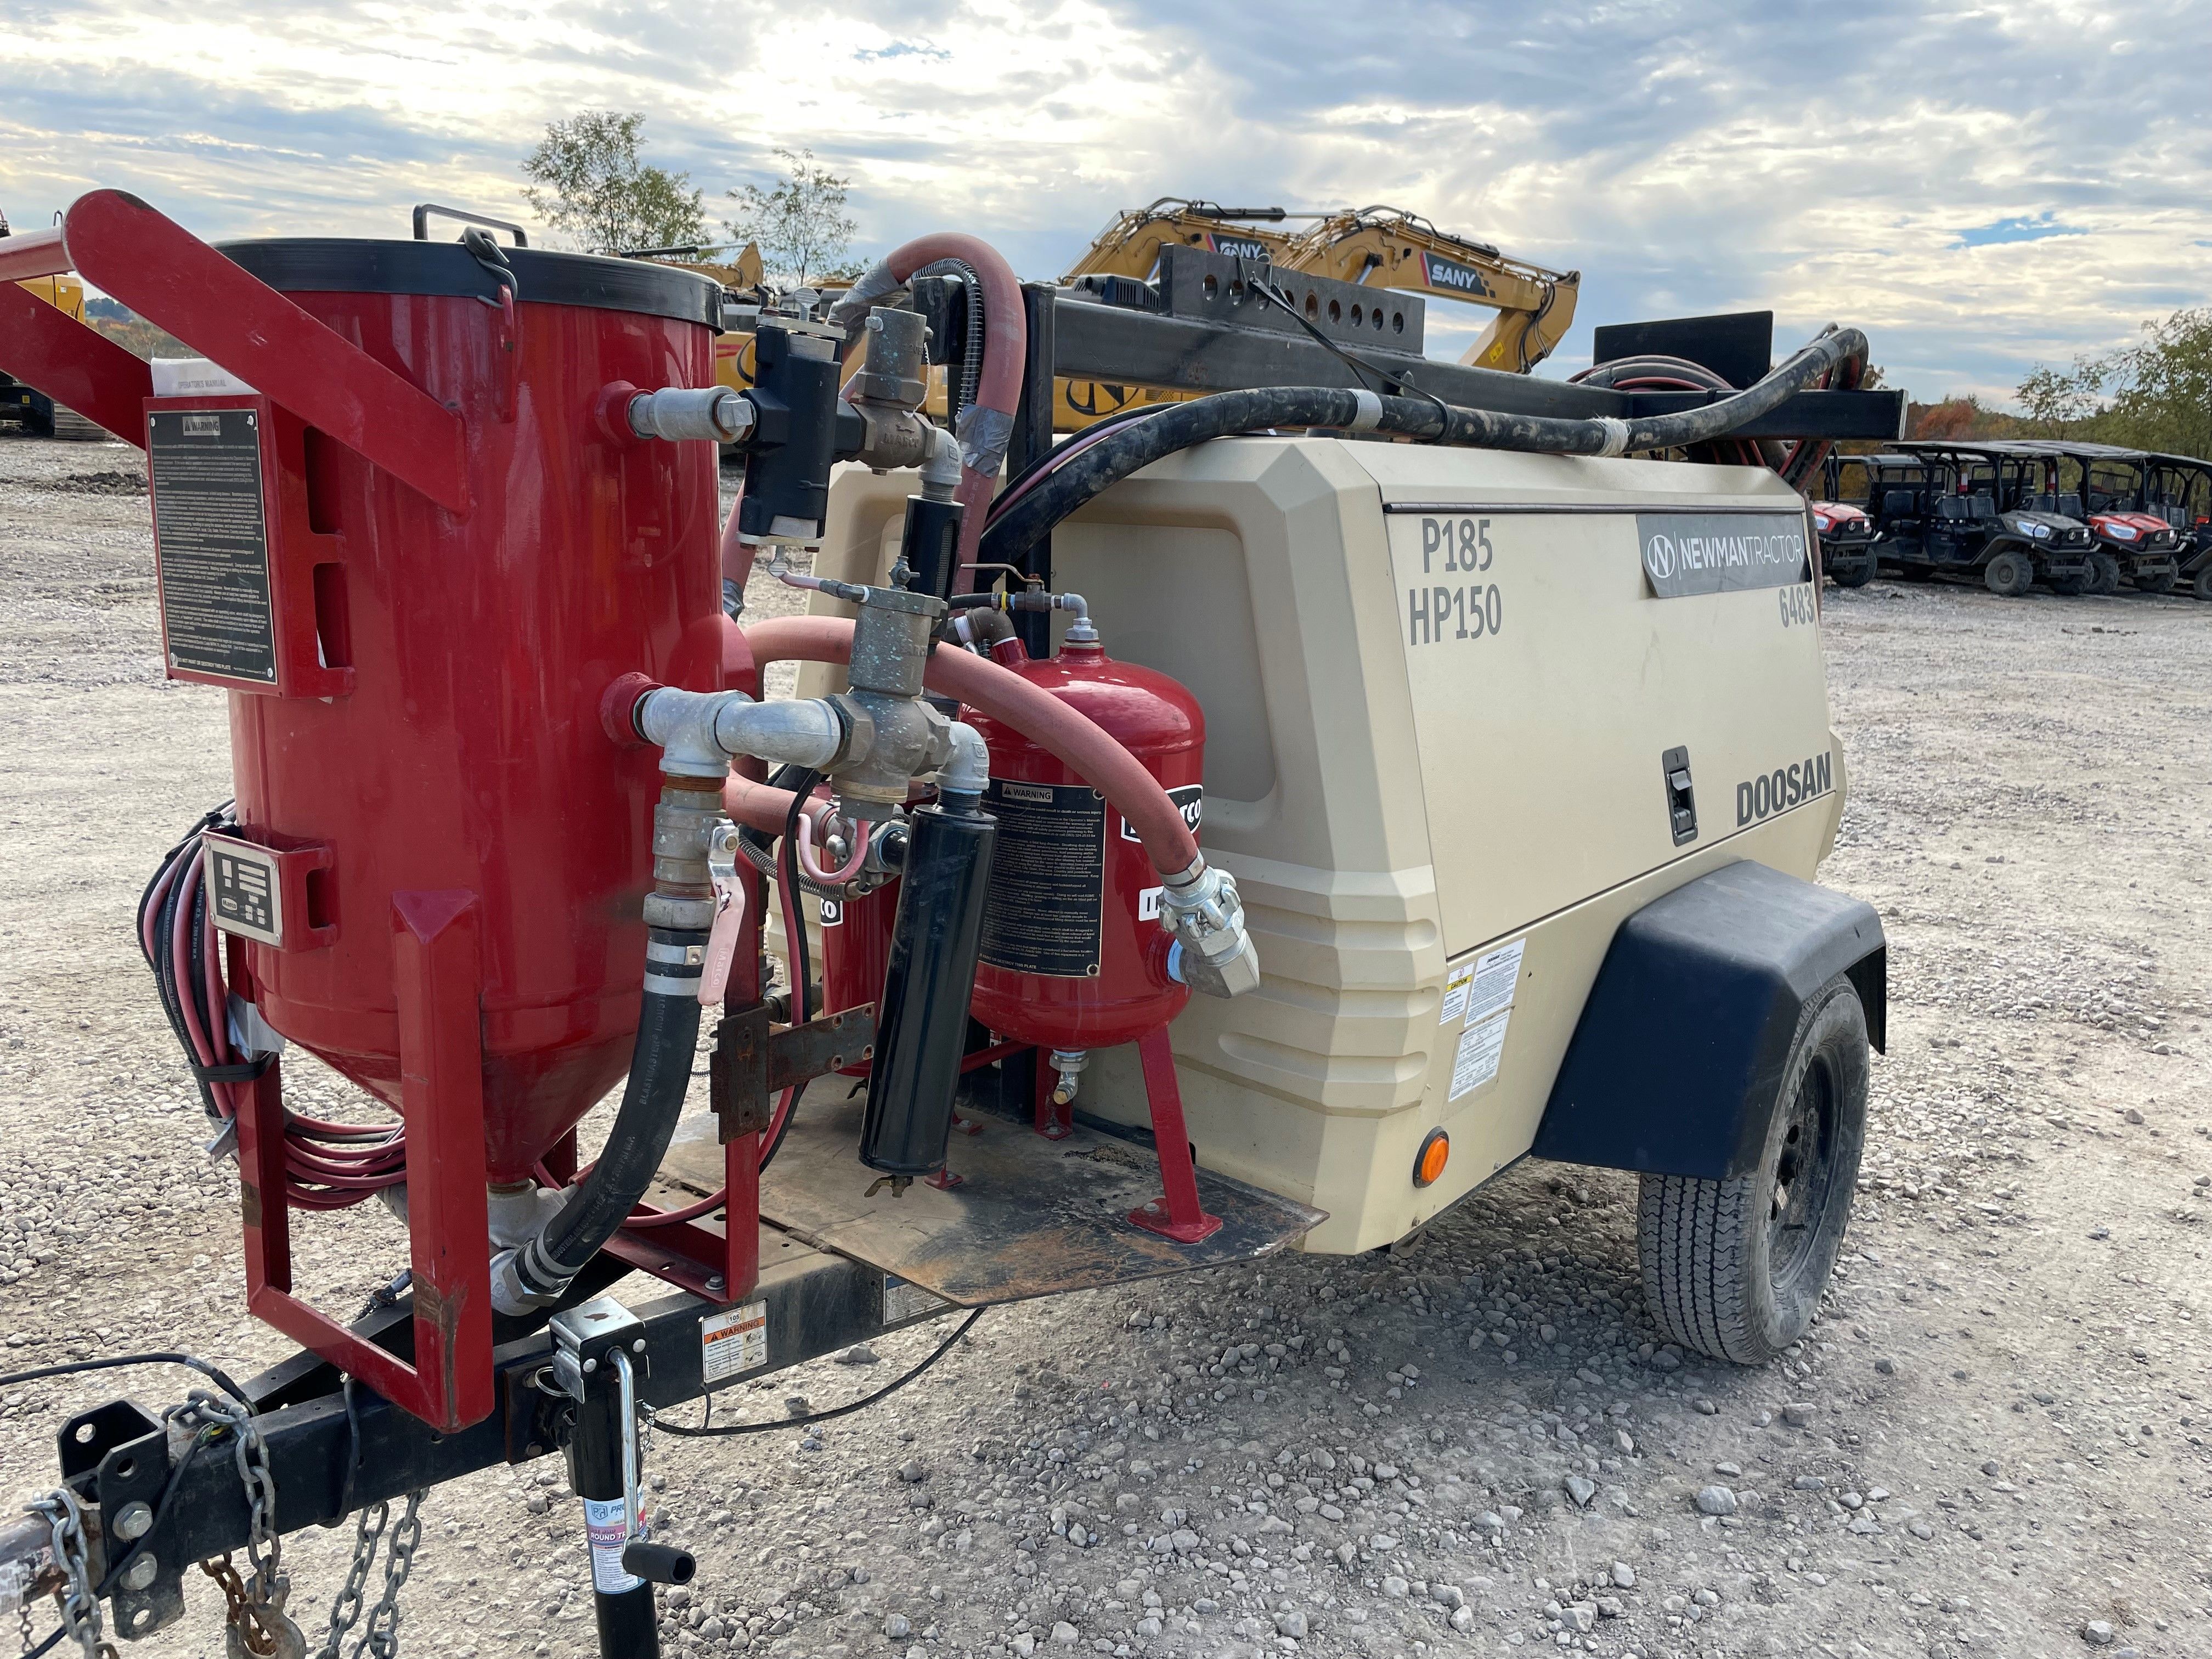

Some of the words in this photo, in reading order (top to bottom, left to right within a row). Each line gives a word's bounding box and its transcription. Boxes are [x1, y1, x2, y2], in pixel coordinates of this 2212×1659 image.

[1220, 242, 1261, 258] SANY
[1431, 264, 1476, 289] SANY
[205, 379, 227, 387] MANUAL
[192, 421, 219, 431] WARNING
[1422, 518, 1492, 573] P185
[1409, 584, 1502, 646] HP150
[1779, 585, 1814, 628] 6483
[1013, 788, 1051, 799] WARNING
[1736, 751, 1831, 827] DOOSAN
[713, 950, 726, 985] Marco
[1451, 977, 1468, 989] CAUTION
[720, 1320, 759, 1337] WARNING
[591, 1533, 616, 1541] ROUND
